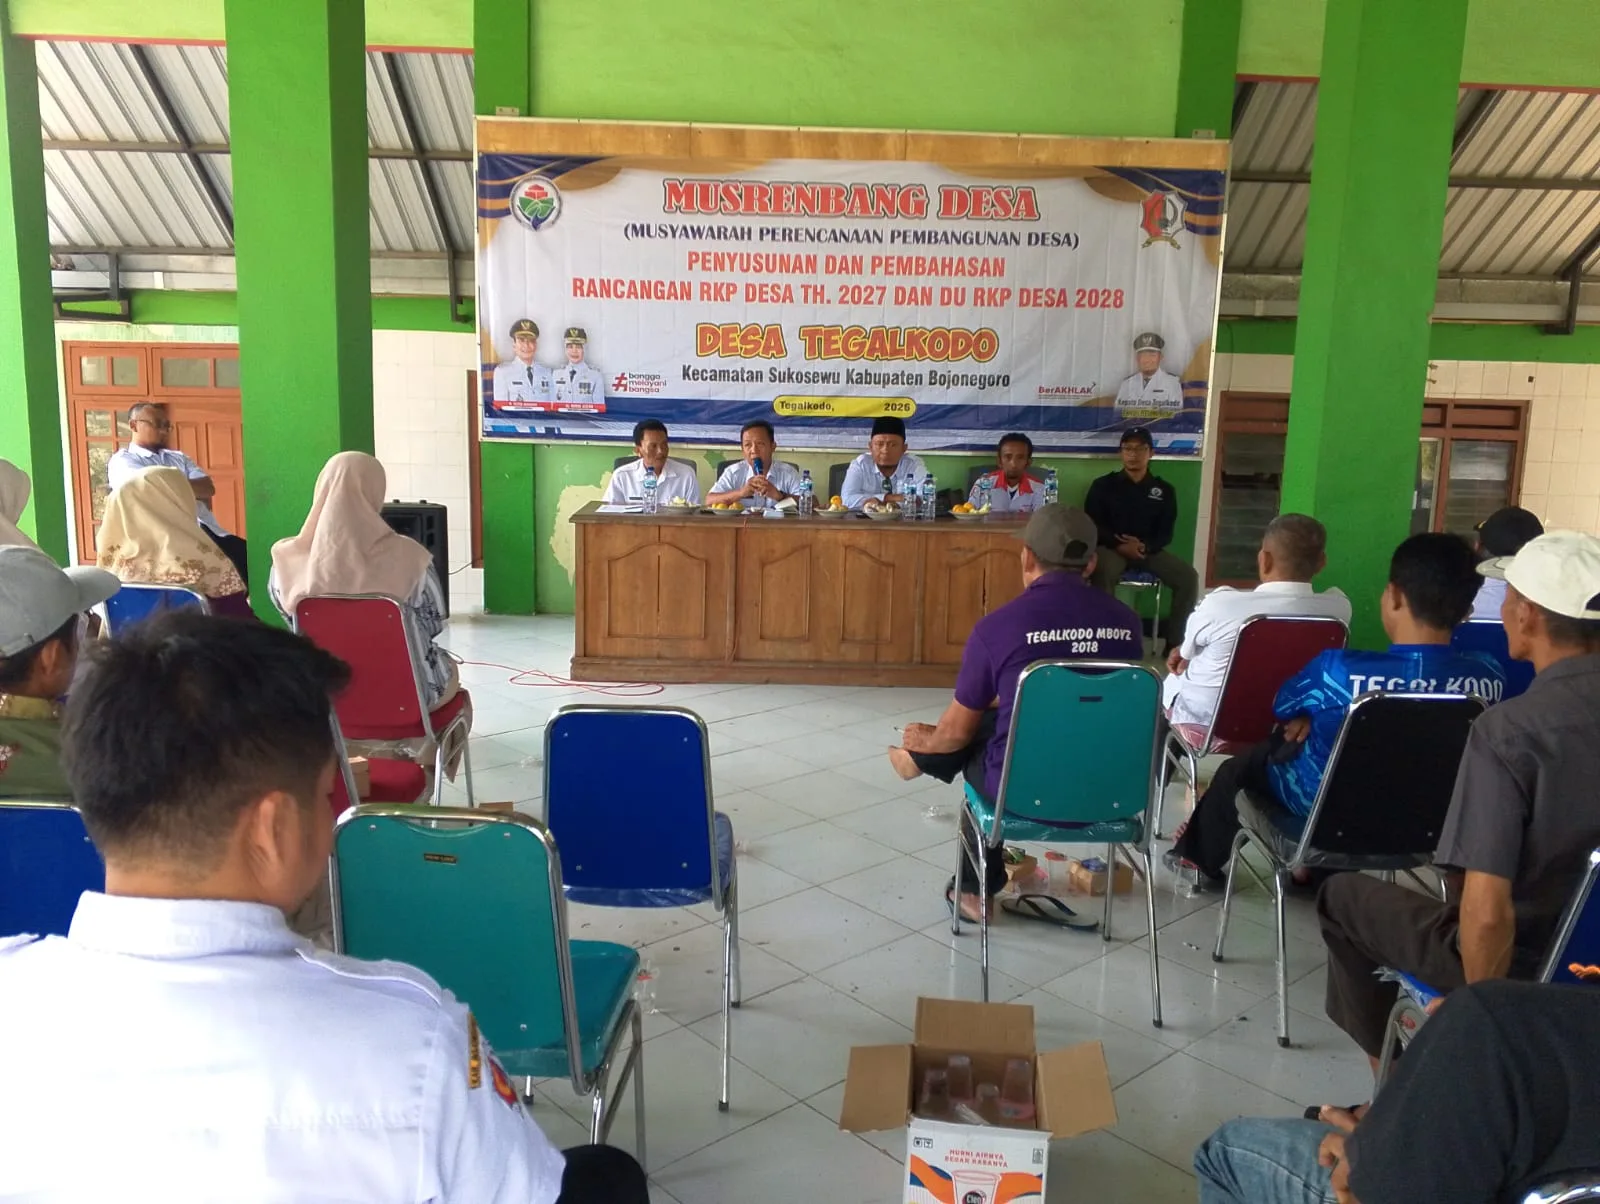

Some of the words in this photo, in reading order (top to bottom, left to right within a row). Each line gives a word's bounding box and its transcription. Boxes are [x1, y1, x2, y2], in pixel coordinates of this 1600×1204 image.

[663, 179, 928, 219] MUSRENBANG
[937, 185, 1040, 221] DESA
[624, 222, 752, 241] (MUSYAWARAH
[759, 227, 884, 245] PERENCANAAN
[890, 229, 1021, 247] PEMBANGUNAN
[1027, 232, 1080, 250] DESA)
[687, 251, 817, 275] PENYUSUNAN
[825, 254, 863, 276] DAN
[870, 255, 1006, 278] PEMBAHASAN
[572, 277, 692, 301] RANCANGAN
[700, 281, 737, 302] RKP
[744, 282, 794, 304] DESA
[800, 284, 832, 305] TH.
[838, 285, 887, 306] 2027
[894, 286, 933, 306] DAN
[940, 286, 966, 307] DU
[973, 287, 1012, 307] RKP
[1019, 288, 1068, 309] DESA
[1075, 288, 1125, 309] 2028
[696, 322, 787, 359] DESA
[800, 325, 999, 363] TEGALKODO
[682, 364, 764, 384] Kecamatan
[768, 367, 841, 385] Sukosewu
[846, 368, 923, 389] Kabupaten
[928, 370, 1011, 391] Bojonegoro
[1038, 386, 1093, 394] BerAKHLAK
[779, 401, 835, 413] Tegalkodo,
[884, 403, 912, 413] 2026
[1025, 628, 1094, 645] TEGALKODO
[1096, 628, 1133, 641] MBOYZ
[1071, 641, 1099, 653] 2018
